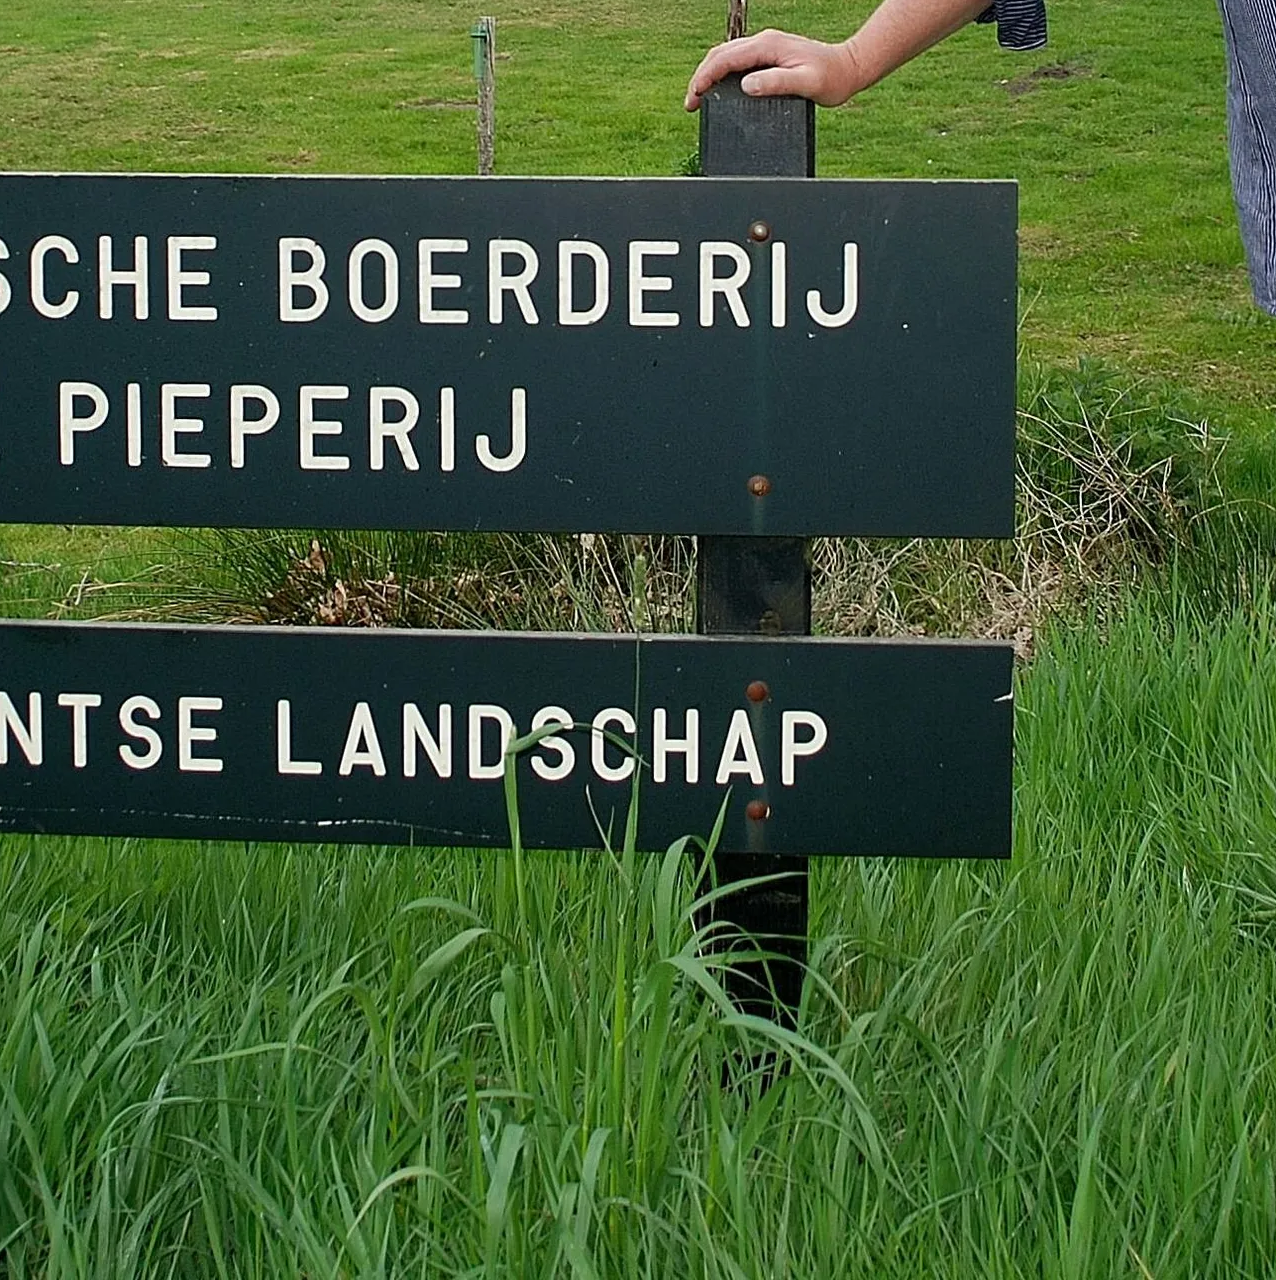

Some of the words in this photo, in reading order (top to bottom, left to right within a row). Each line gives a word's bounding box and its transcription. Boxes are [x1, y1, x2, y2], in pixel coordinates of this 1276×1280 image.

[277, 236, 859, 329] BOERDERIJ
[58, 380, 527, 473] PIEPERIJ
[276, 698, 829, 787] LANDSCHAP
